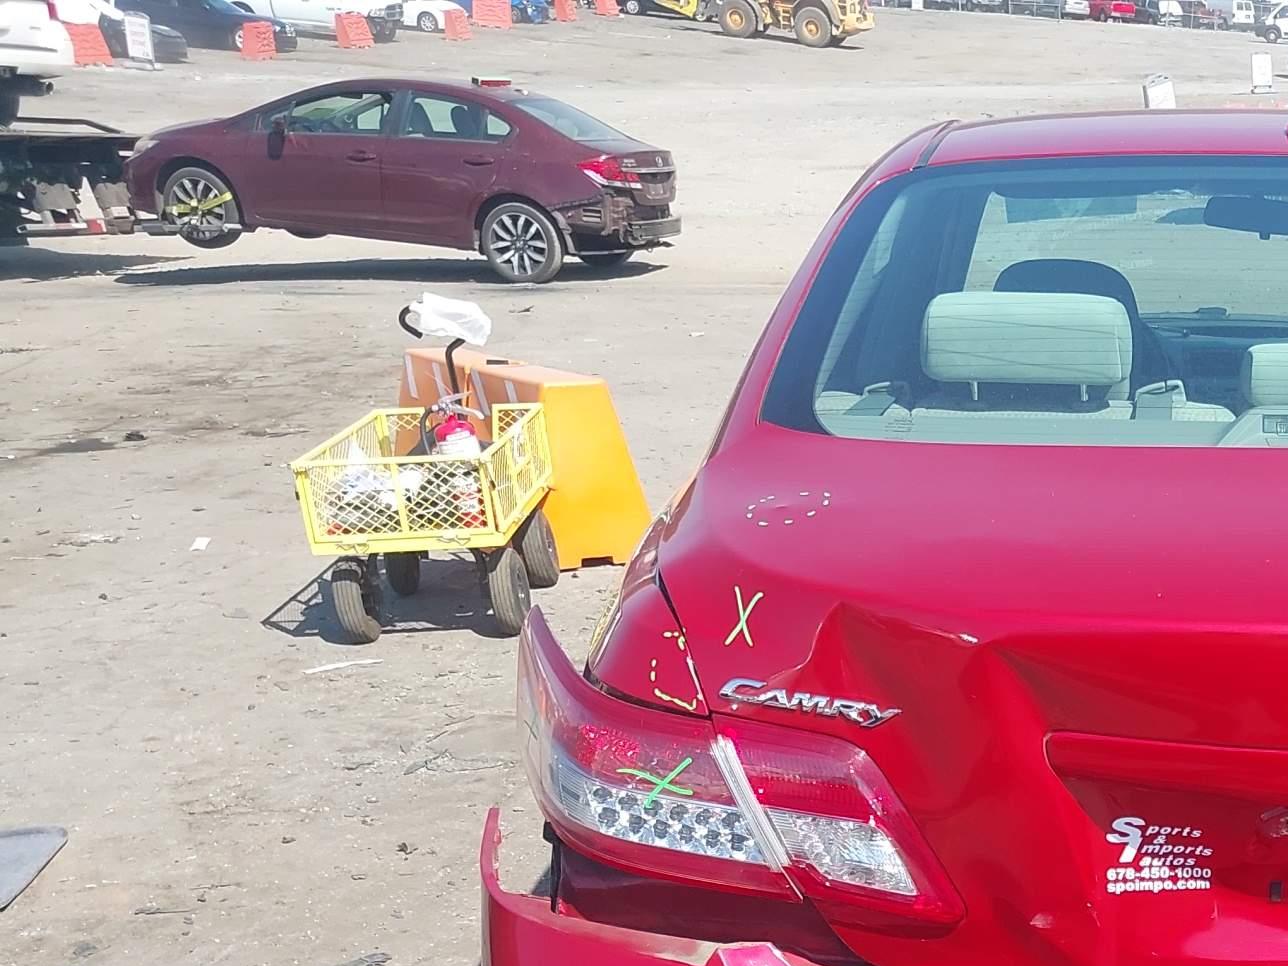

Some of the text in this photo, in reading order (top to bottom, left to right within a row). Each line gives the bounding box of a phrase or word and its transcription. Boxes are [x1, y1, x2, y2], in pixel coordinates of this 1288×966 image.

[719, 678, 903, 728] CAMRY
[1138, 855, 1197, 867] autos
[1106, 880, 1211, 894] spoimpo.com
